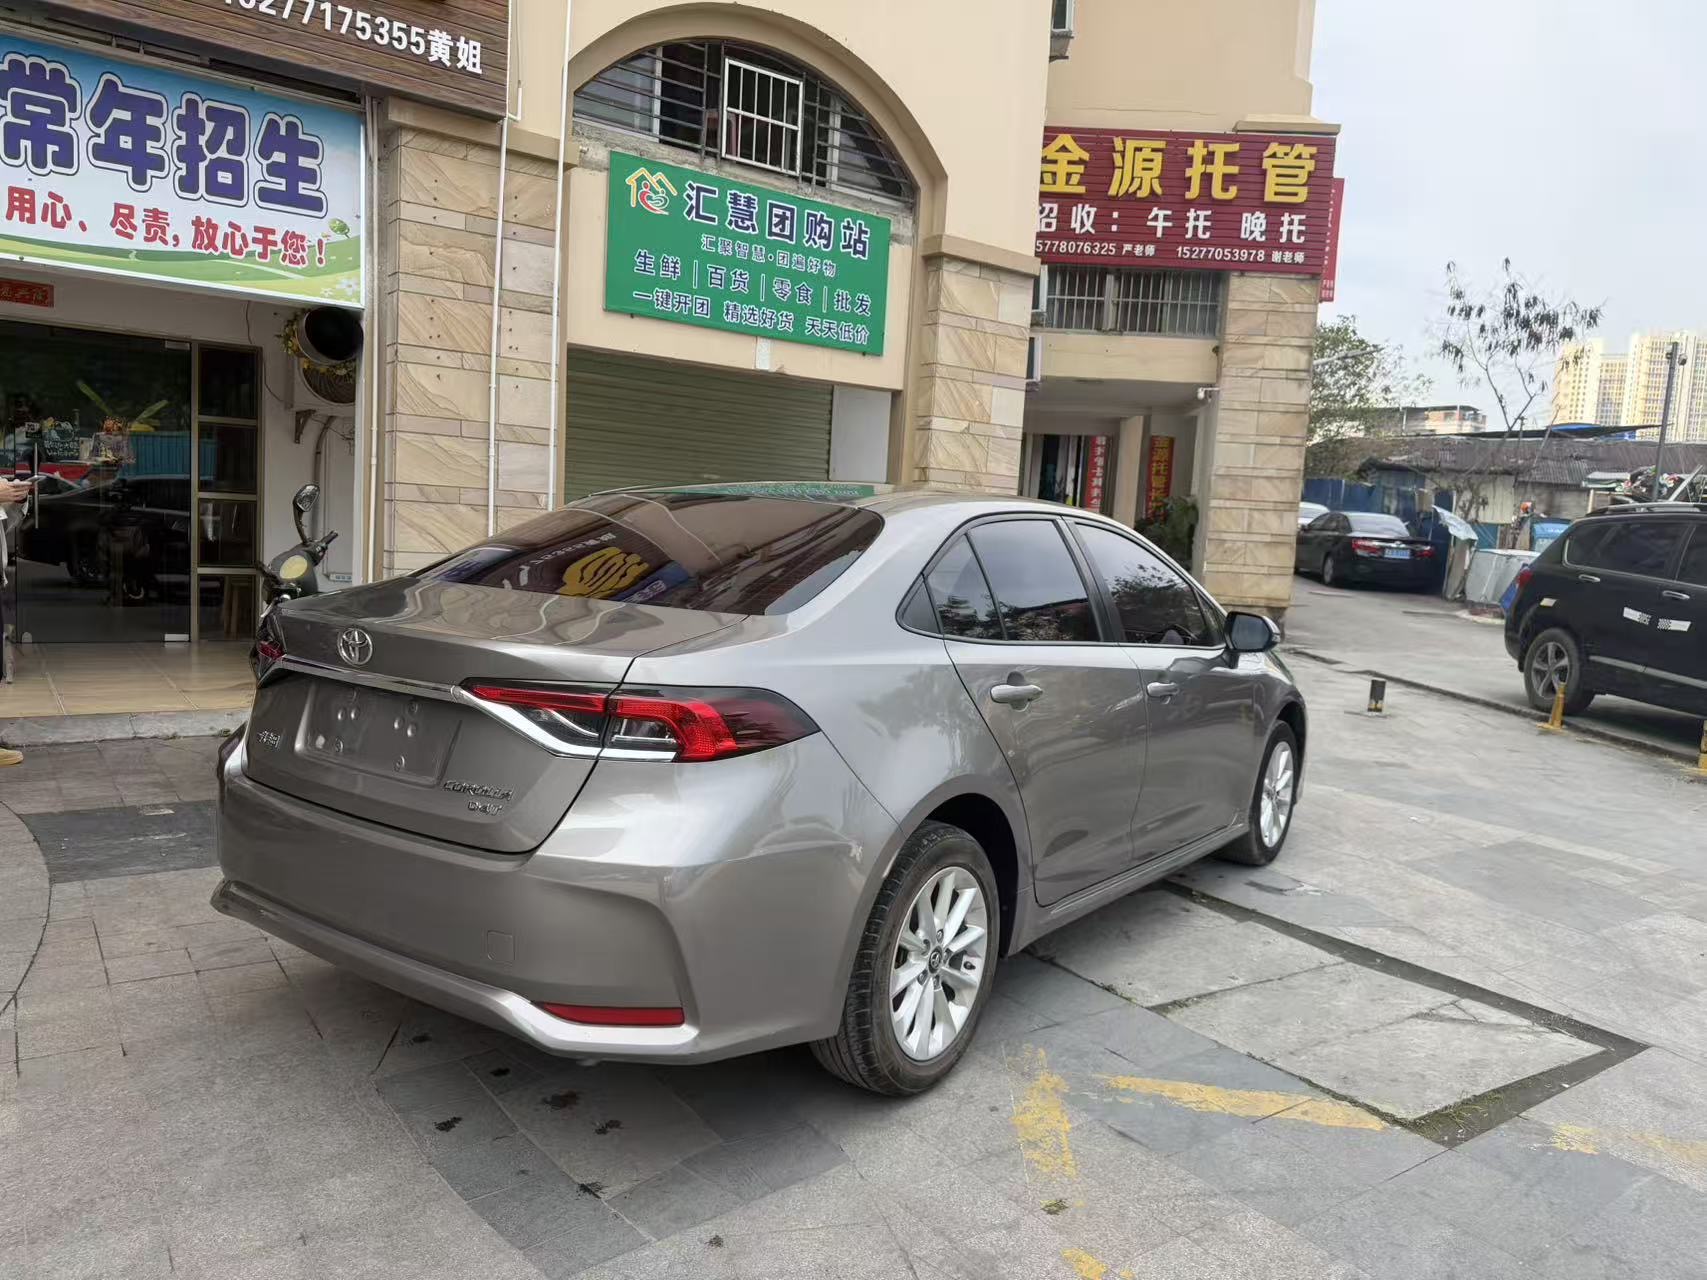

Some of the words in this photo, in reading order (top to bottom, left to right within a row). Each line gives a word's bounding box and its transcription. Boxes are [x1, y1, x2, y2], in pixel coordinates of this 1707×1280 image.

[0, 54, 327, 217] 常年招生
[1040, 134, 1317, 203] 金源托管
[684, 182, 870, 260] 汇慧团购站
[1122, 244, 1156, 257] 严老师
[1176, 246, 1265, 262] 15277053978
[1146, 207, 1212, 239] 午托
[1240, 212, 1306, 243] 晚托
[633, 287, 711, 318] 一键开团
[723, 301, 794, 332] 精选好货
[805, 316, 869, 345] 天天低价
[634, 250, 681, 280] 生鲜
[707, 265, 749, 293] 百货
[772, 278, 813, 305] 零食
[834, 289, 871, 317] 批发
